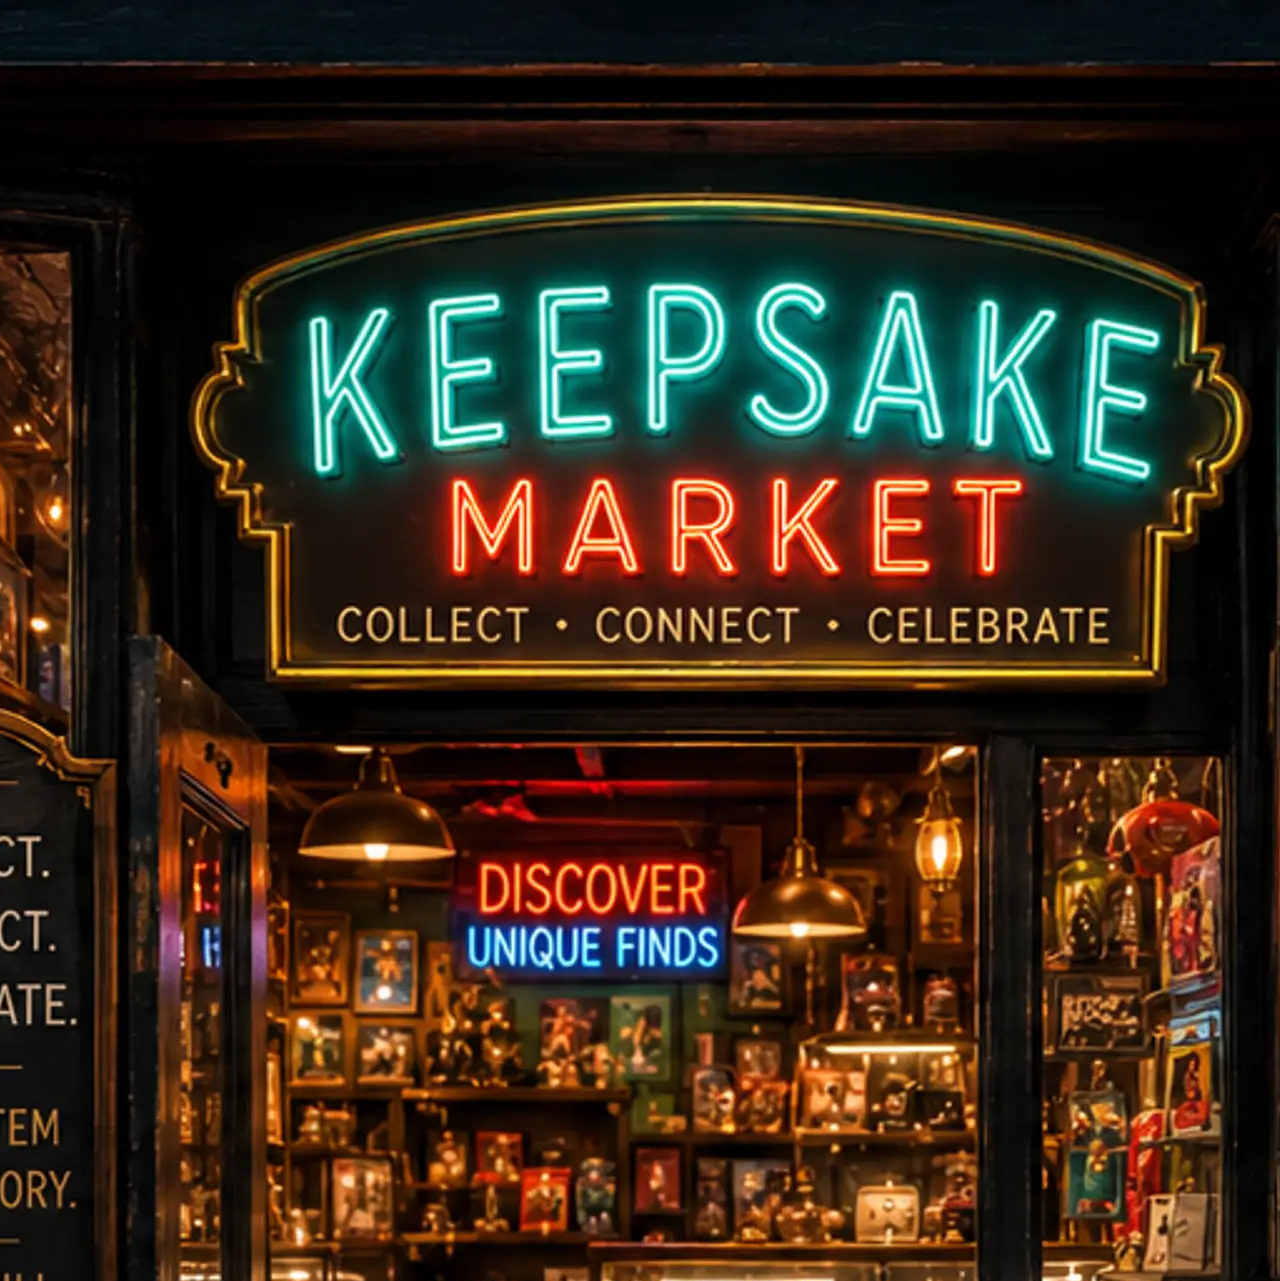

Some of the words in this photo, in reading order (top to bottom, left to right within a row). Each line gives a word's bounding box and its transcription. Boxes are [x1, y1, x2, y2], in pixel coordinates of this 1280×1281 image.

[308, 282, 1162, 479] KEEPSAKE
[448, 477, 1024, 576] MARKET
[337, 606, 530, 642] COLLECT
[595, 606, 800, 643] CONNECT
[868, 606, 1110, 643] CELEBRATE
[480, 861, 706, 914] DISCOVER
[468, 926, 602, 971] UNIQUE
[617, 926, 719, 967] FINDS
